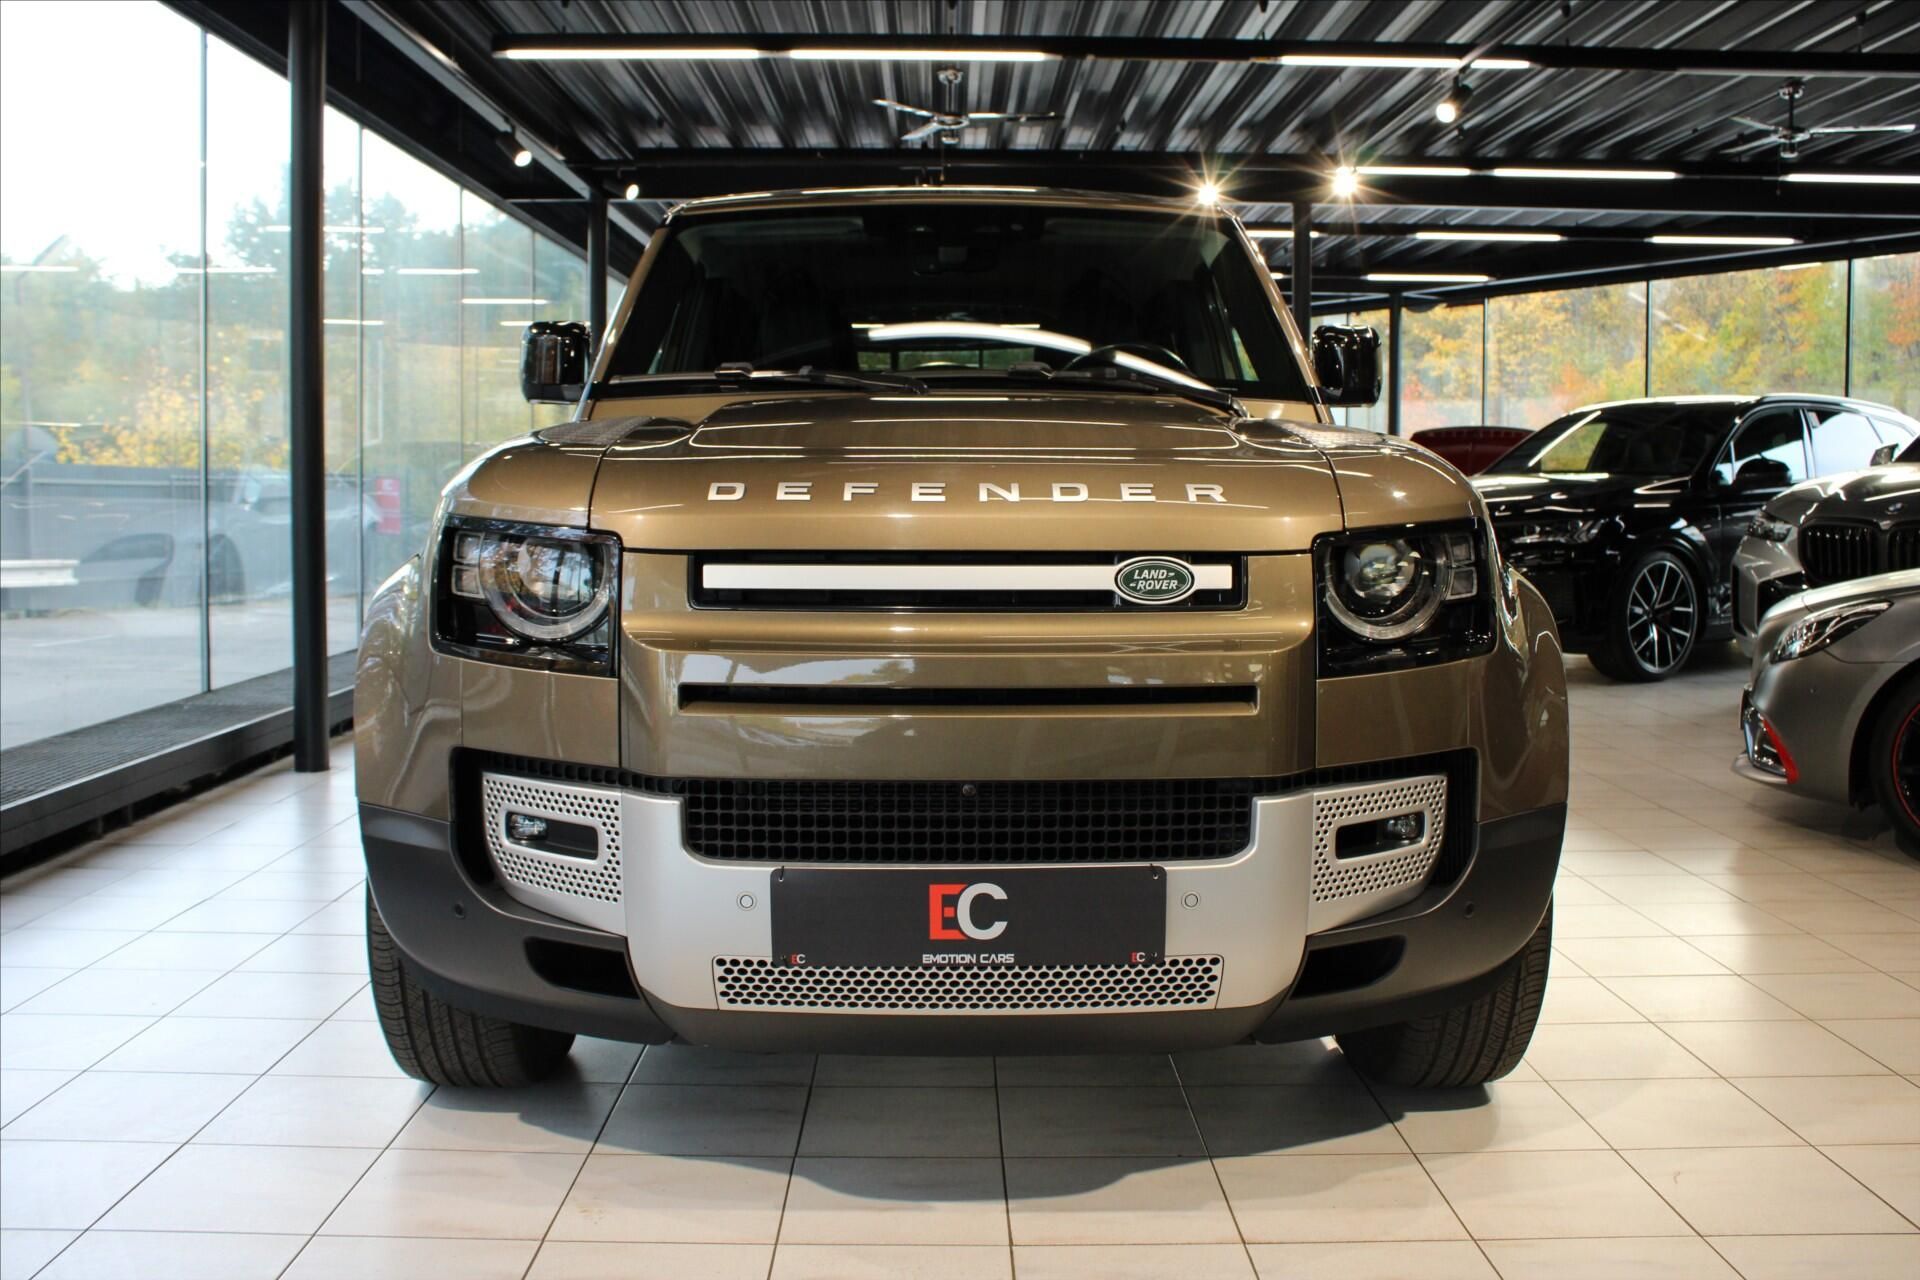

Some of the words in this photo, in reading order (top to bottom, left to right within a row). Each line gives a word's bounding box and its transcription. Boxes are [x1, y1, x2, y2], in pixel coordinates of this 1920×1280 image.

[707, 482, 1227, 502] DEFENDER
[929, 882, 1009, 940] EC
[922, 953, 976, 964] EMOTION
[979, 953, 1015, 964] CARS
